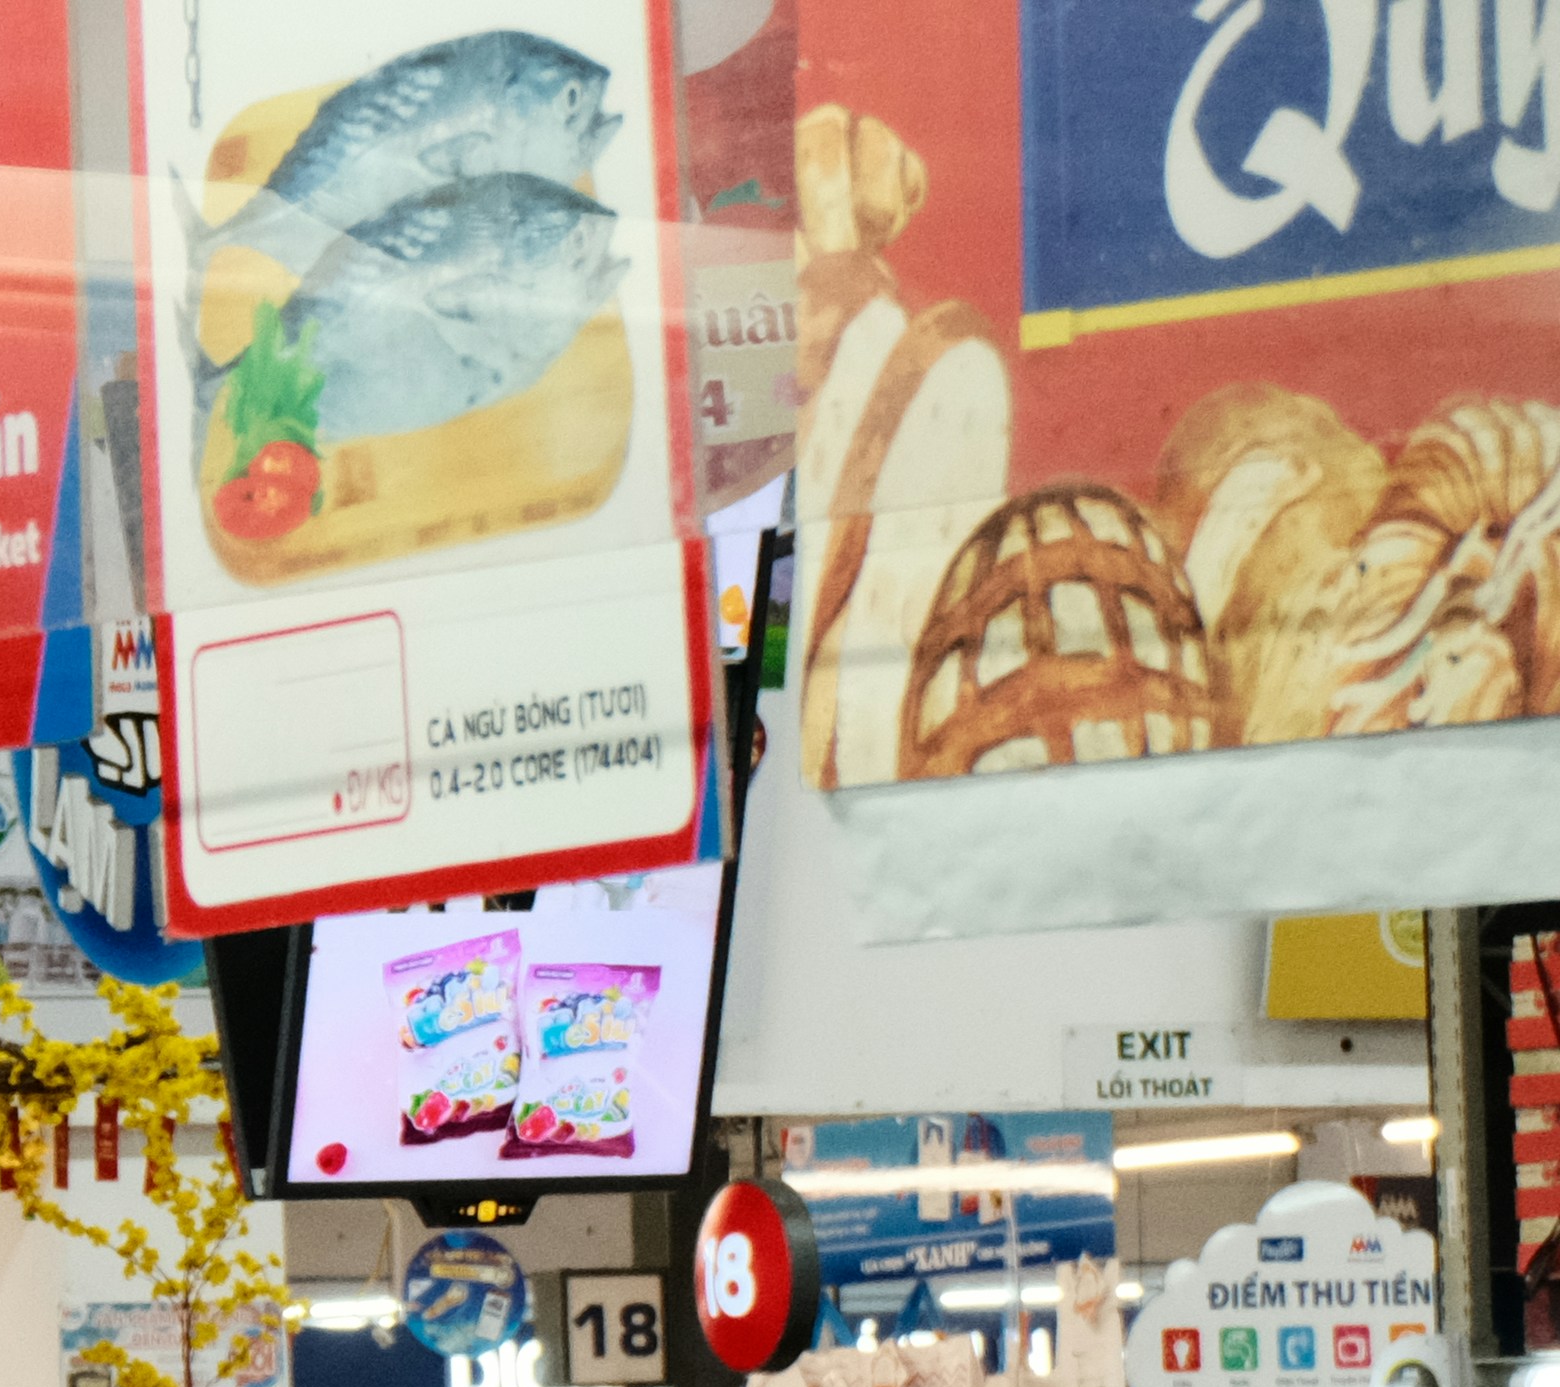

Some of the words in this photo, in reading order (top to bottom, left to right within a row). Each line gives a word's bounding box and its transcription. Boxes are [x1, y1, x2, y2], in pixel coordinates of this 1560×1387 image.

[513, 747, 568, 788] CORE
[1117, 1032, 1190, 1061] EXIT
[702, 1232, 757, 1318] 18
[1294, 1279, 1356, 1308] THU
[573, 1302, 659, 1359] 18
